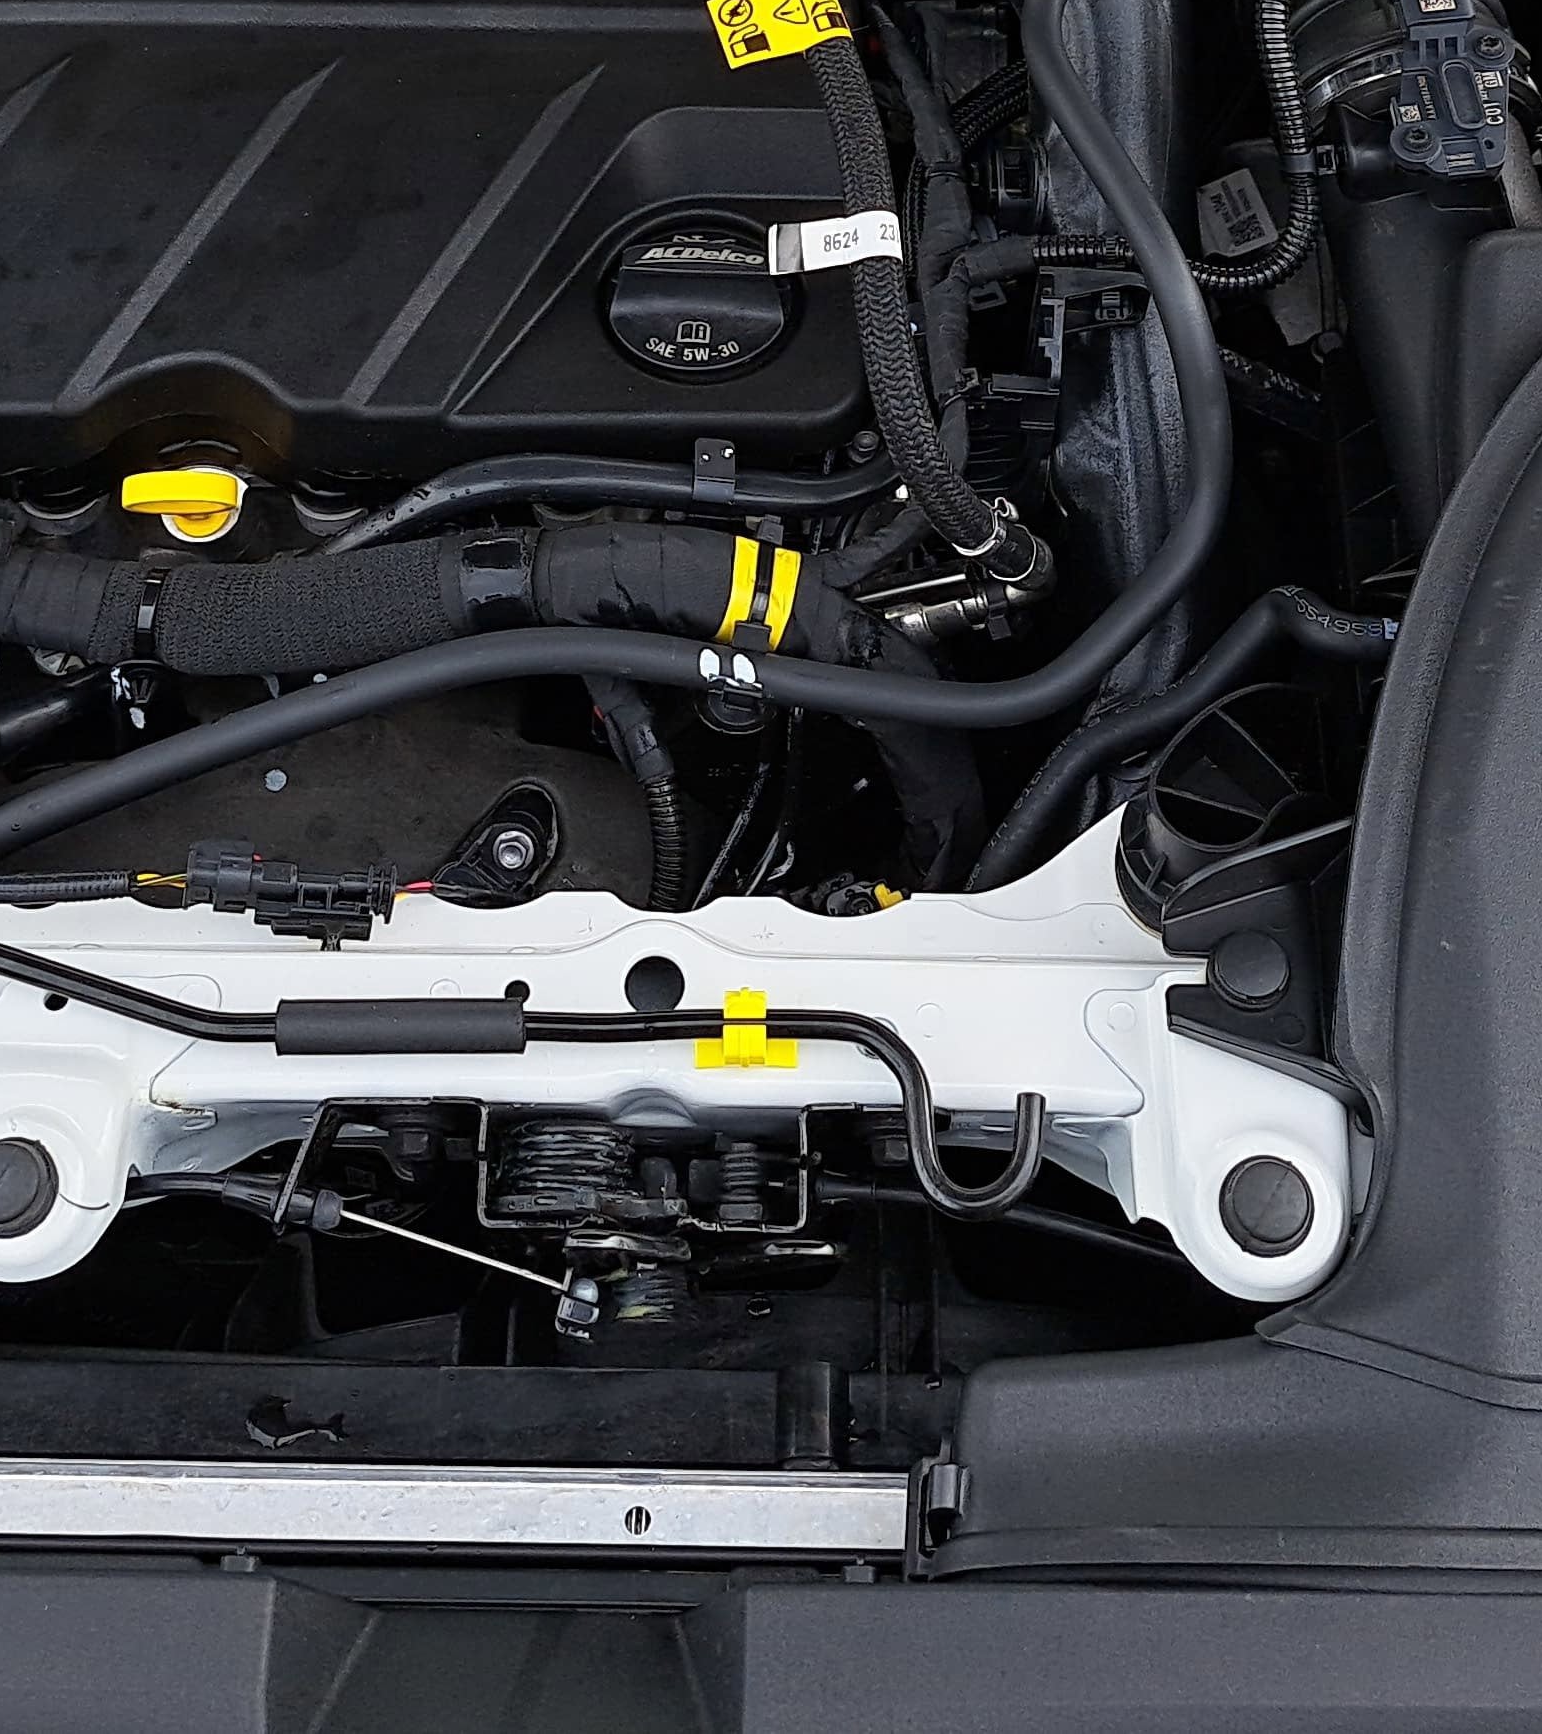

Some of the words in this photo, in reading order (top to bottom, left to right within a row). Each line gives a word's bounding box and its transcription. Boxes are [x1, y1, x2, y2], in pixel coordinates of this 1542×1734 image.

[824, 228, 859, 252] 8624
[641, 247, 765, 264] ACDelco
[645, 337, 677, 358] SAE
[683, 341, 740, 361] 5W-30
